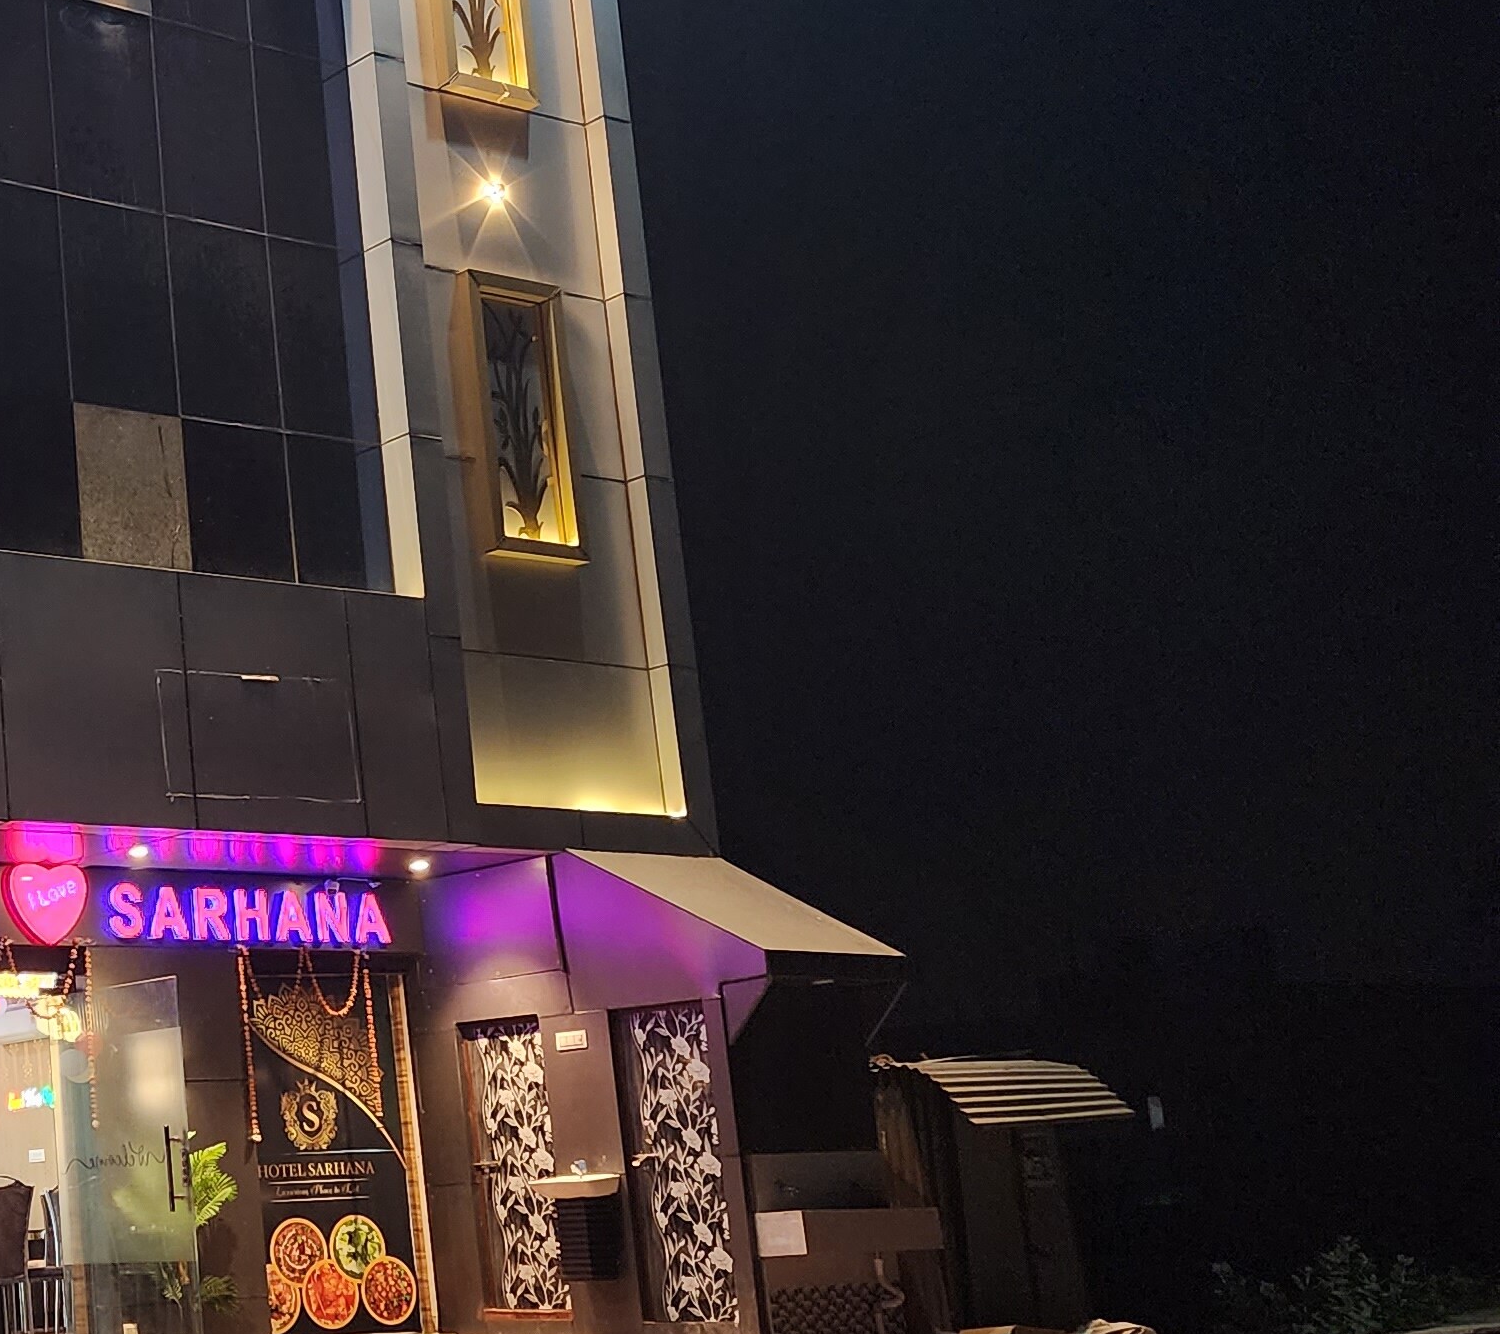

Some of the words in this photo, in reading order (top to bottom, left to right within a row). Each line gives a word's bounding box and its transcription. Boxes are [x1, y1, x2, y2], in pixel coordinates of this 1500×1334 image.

[108, 881, 393, 944] SARHANA
[302, 1101, 320, 1131] S
[258, 1163, 307, 1179] HOTEL
[307, 1160, 375, 1177] SARHANA
